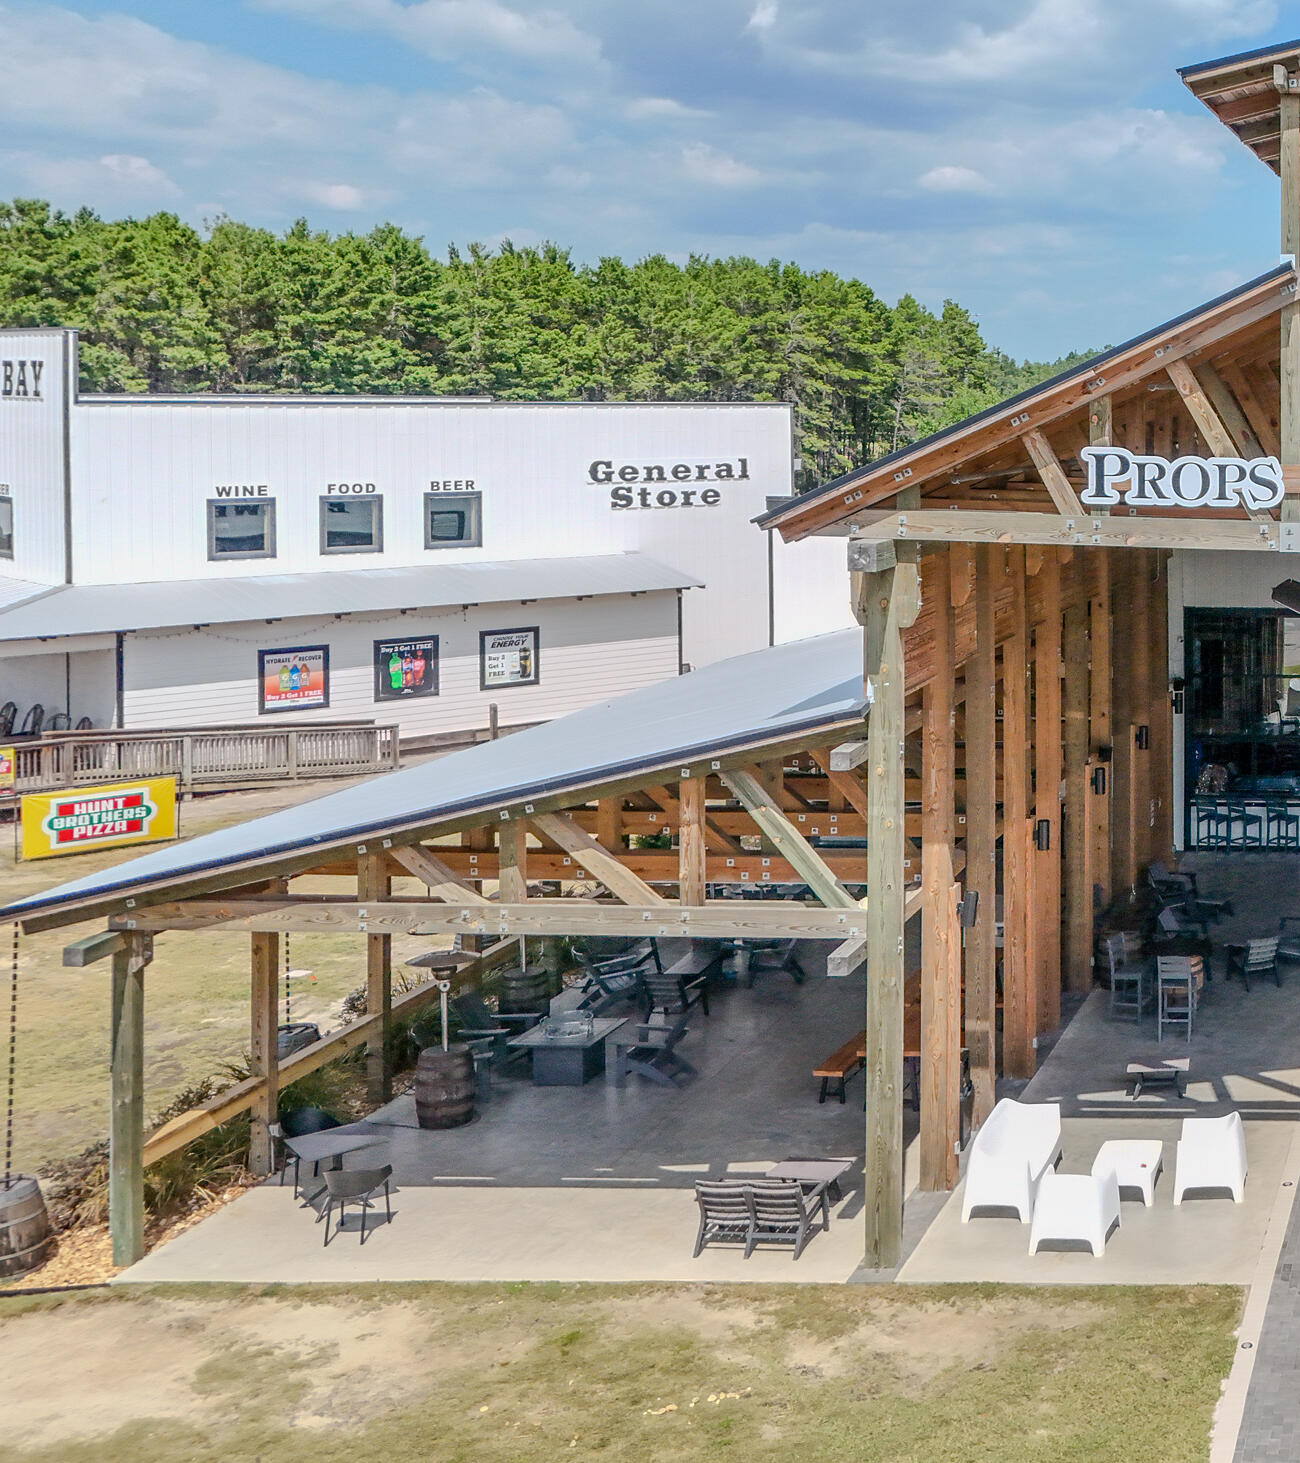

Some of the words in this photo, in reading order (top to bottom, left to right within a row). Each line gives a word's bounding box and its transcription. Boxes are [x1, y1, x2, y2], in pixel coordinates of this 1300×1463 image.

[2, 360, 44, 397] BAY
[588, 458, 750, 483] General
[1087, 452, 1280, 503] PROPS
[215, 485, 269, 498] WINE
[327, 483, 376, 495] FOOD
[430, 480, 476, 492] BEER
[610, 486, 721, 508] Store
[491, 639, 527, 648] ENERGY
[73, 797, 126, 815] HUNT
[53, 806, 147, 829] BROTHERS
[73, 821, 127, 839] PIZZA
